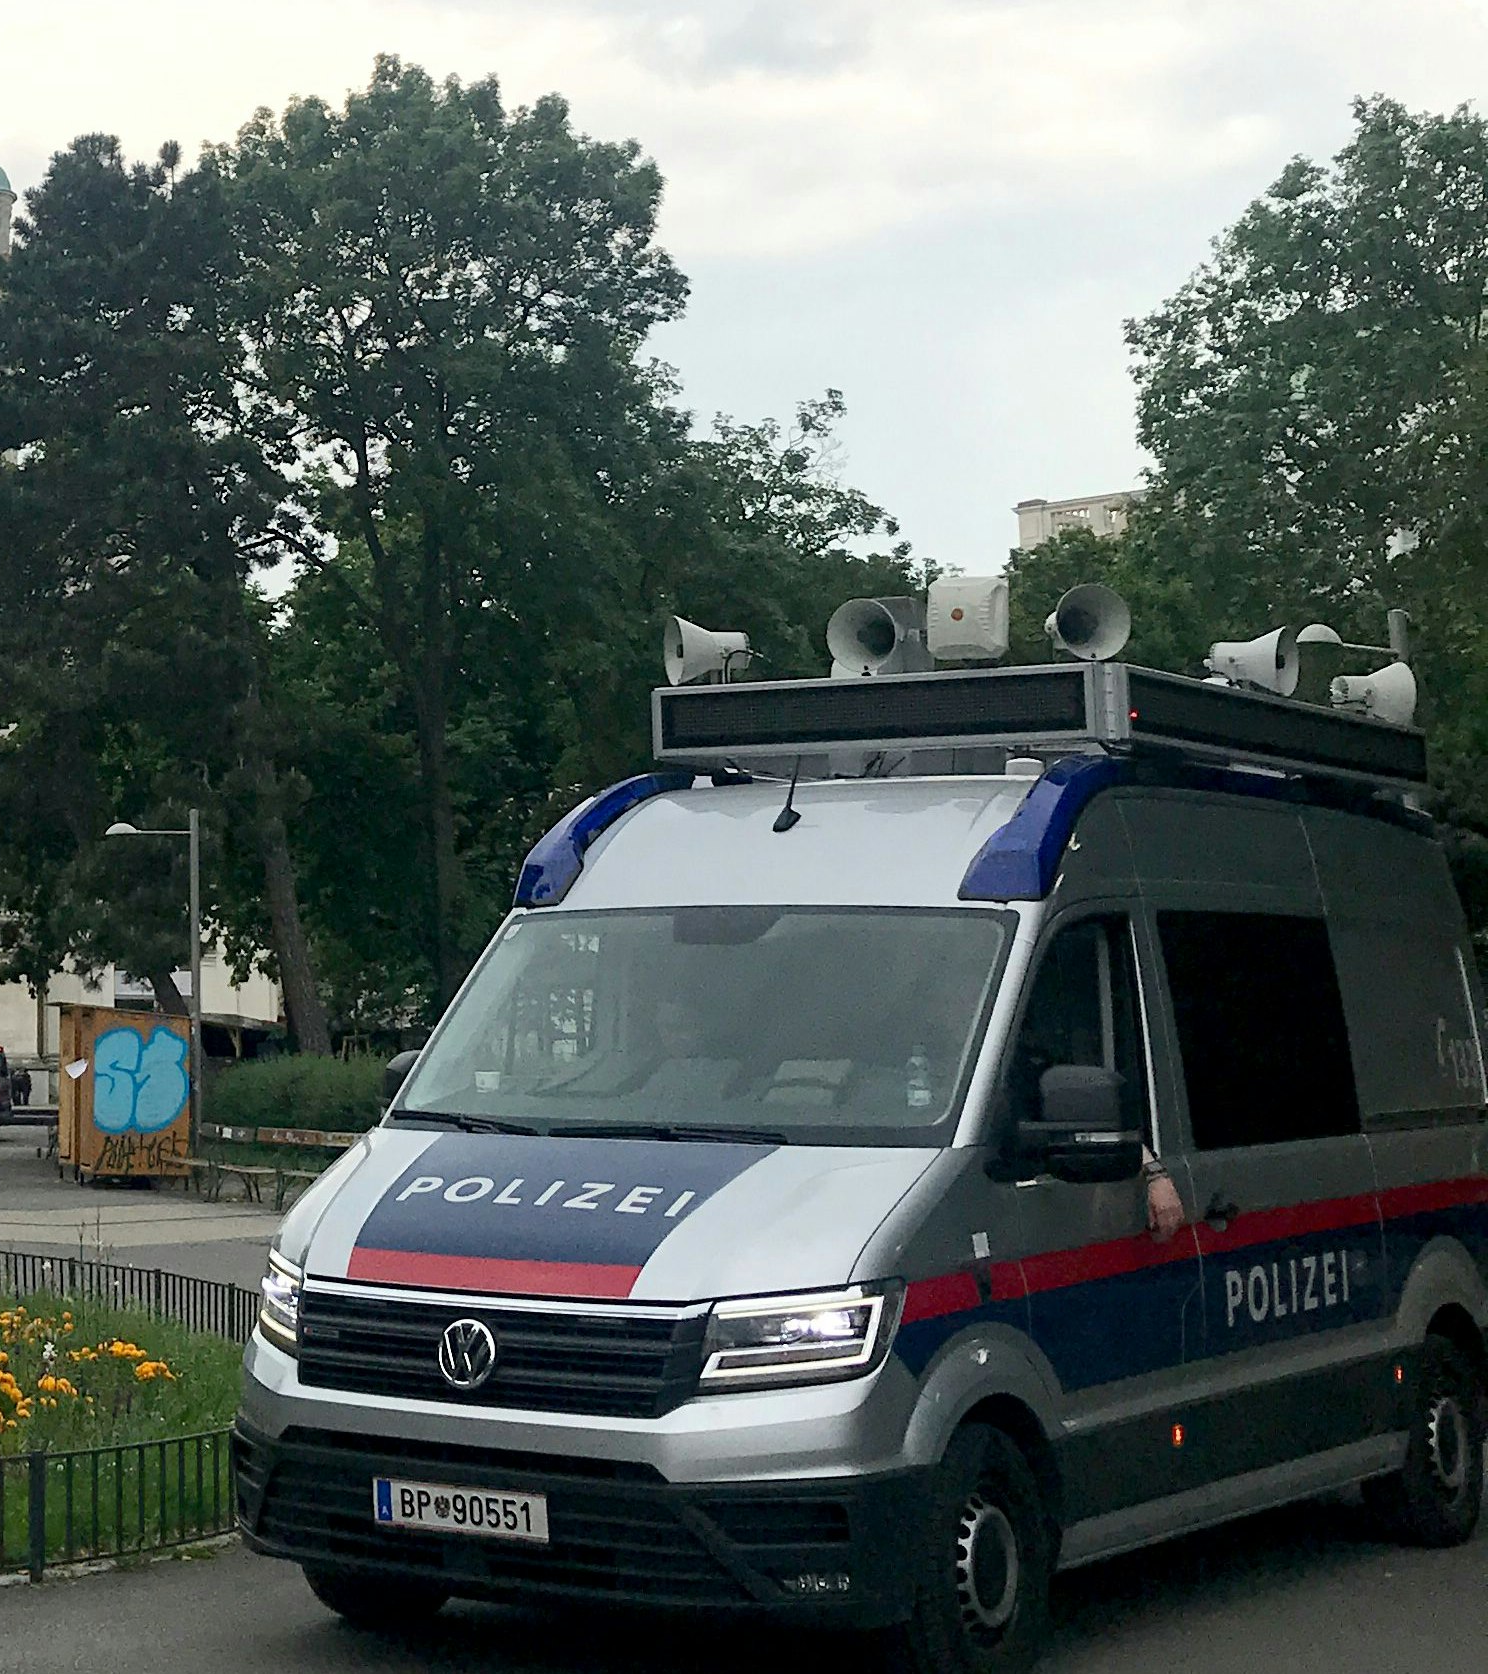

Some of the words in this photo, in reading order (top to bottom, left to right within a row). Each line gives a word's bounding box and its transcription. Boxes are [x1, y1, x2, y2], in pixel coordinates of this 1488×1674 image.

[395, 1176, 696, 1217] POLIZEI
[1225, 1249, 1350, 1328] POLIZEI
[452, 1494, 532, 1532] 90551
